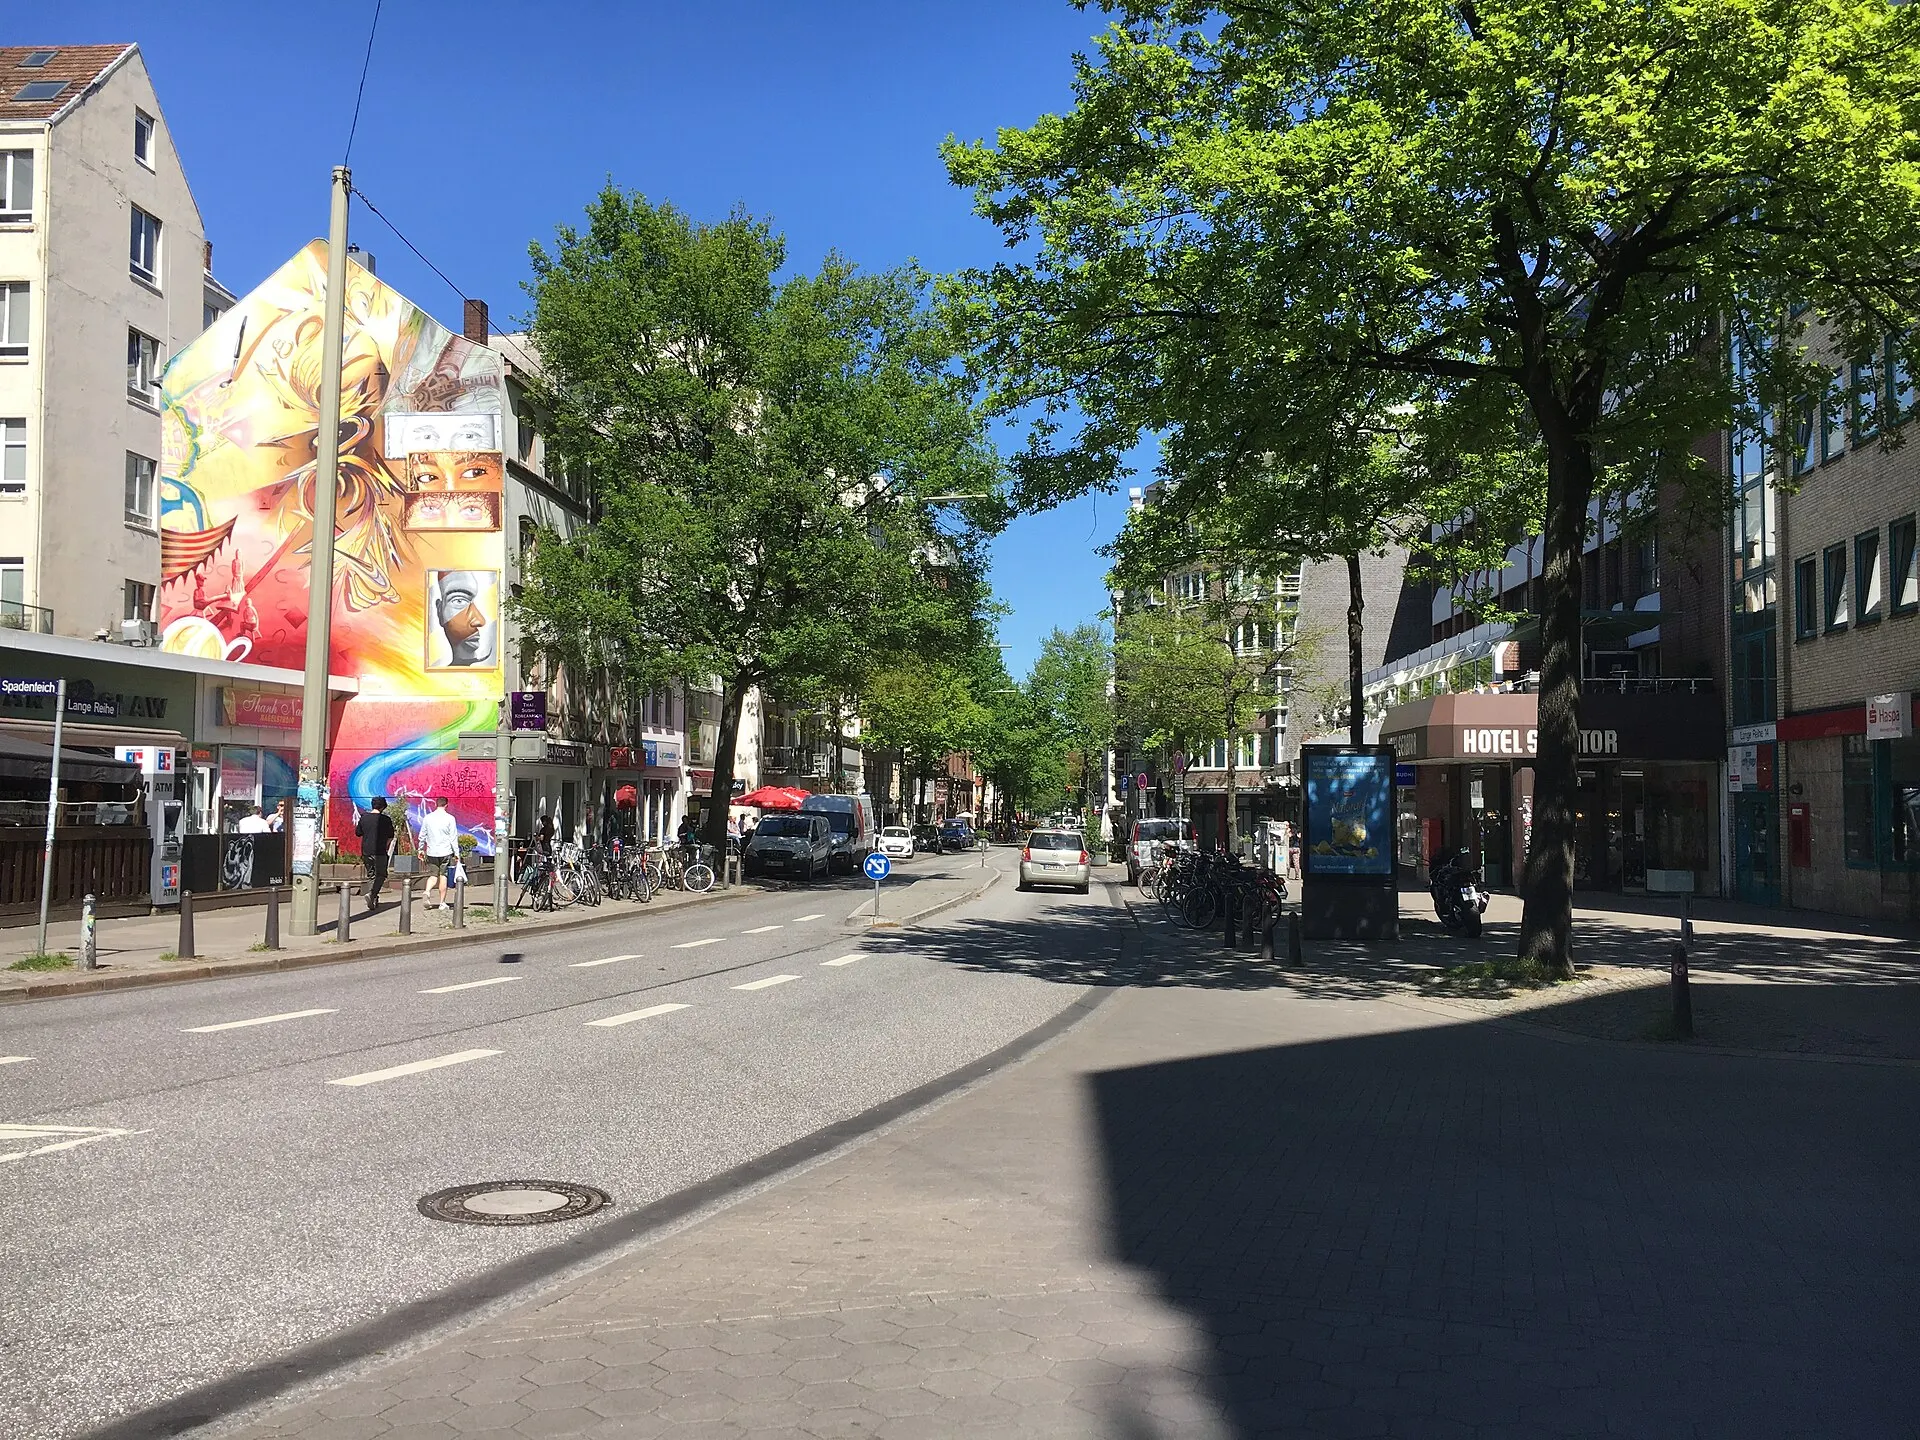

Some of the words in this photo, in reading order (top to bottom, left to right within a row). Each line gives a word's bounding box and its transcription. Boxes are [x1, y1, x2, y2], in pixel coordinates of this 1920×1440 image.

[1, 680, 55, 694] Spadenteich
[67, 699, 92, 714] Lange
[93, 701, 115, 715] Reihe
[1879, 707, 1900, 725] Haspa
[1463, 729, 1522, 754] HOTEL
[155, 782, 172, 792] ATM
[163, 888, 178, 897] ATM
